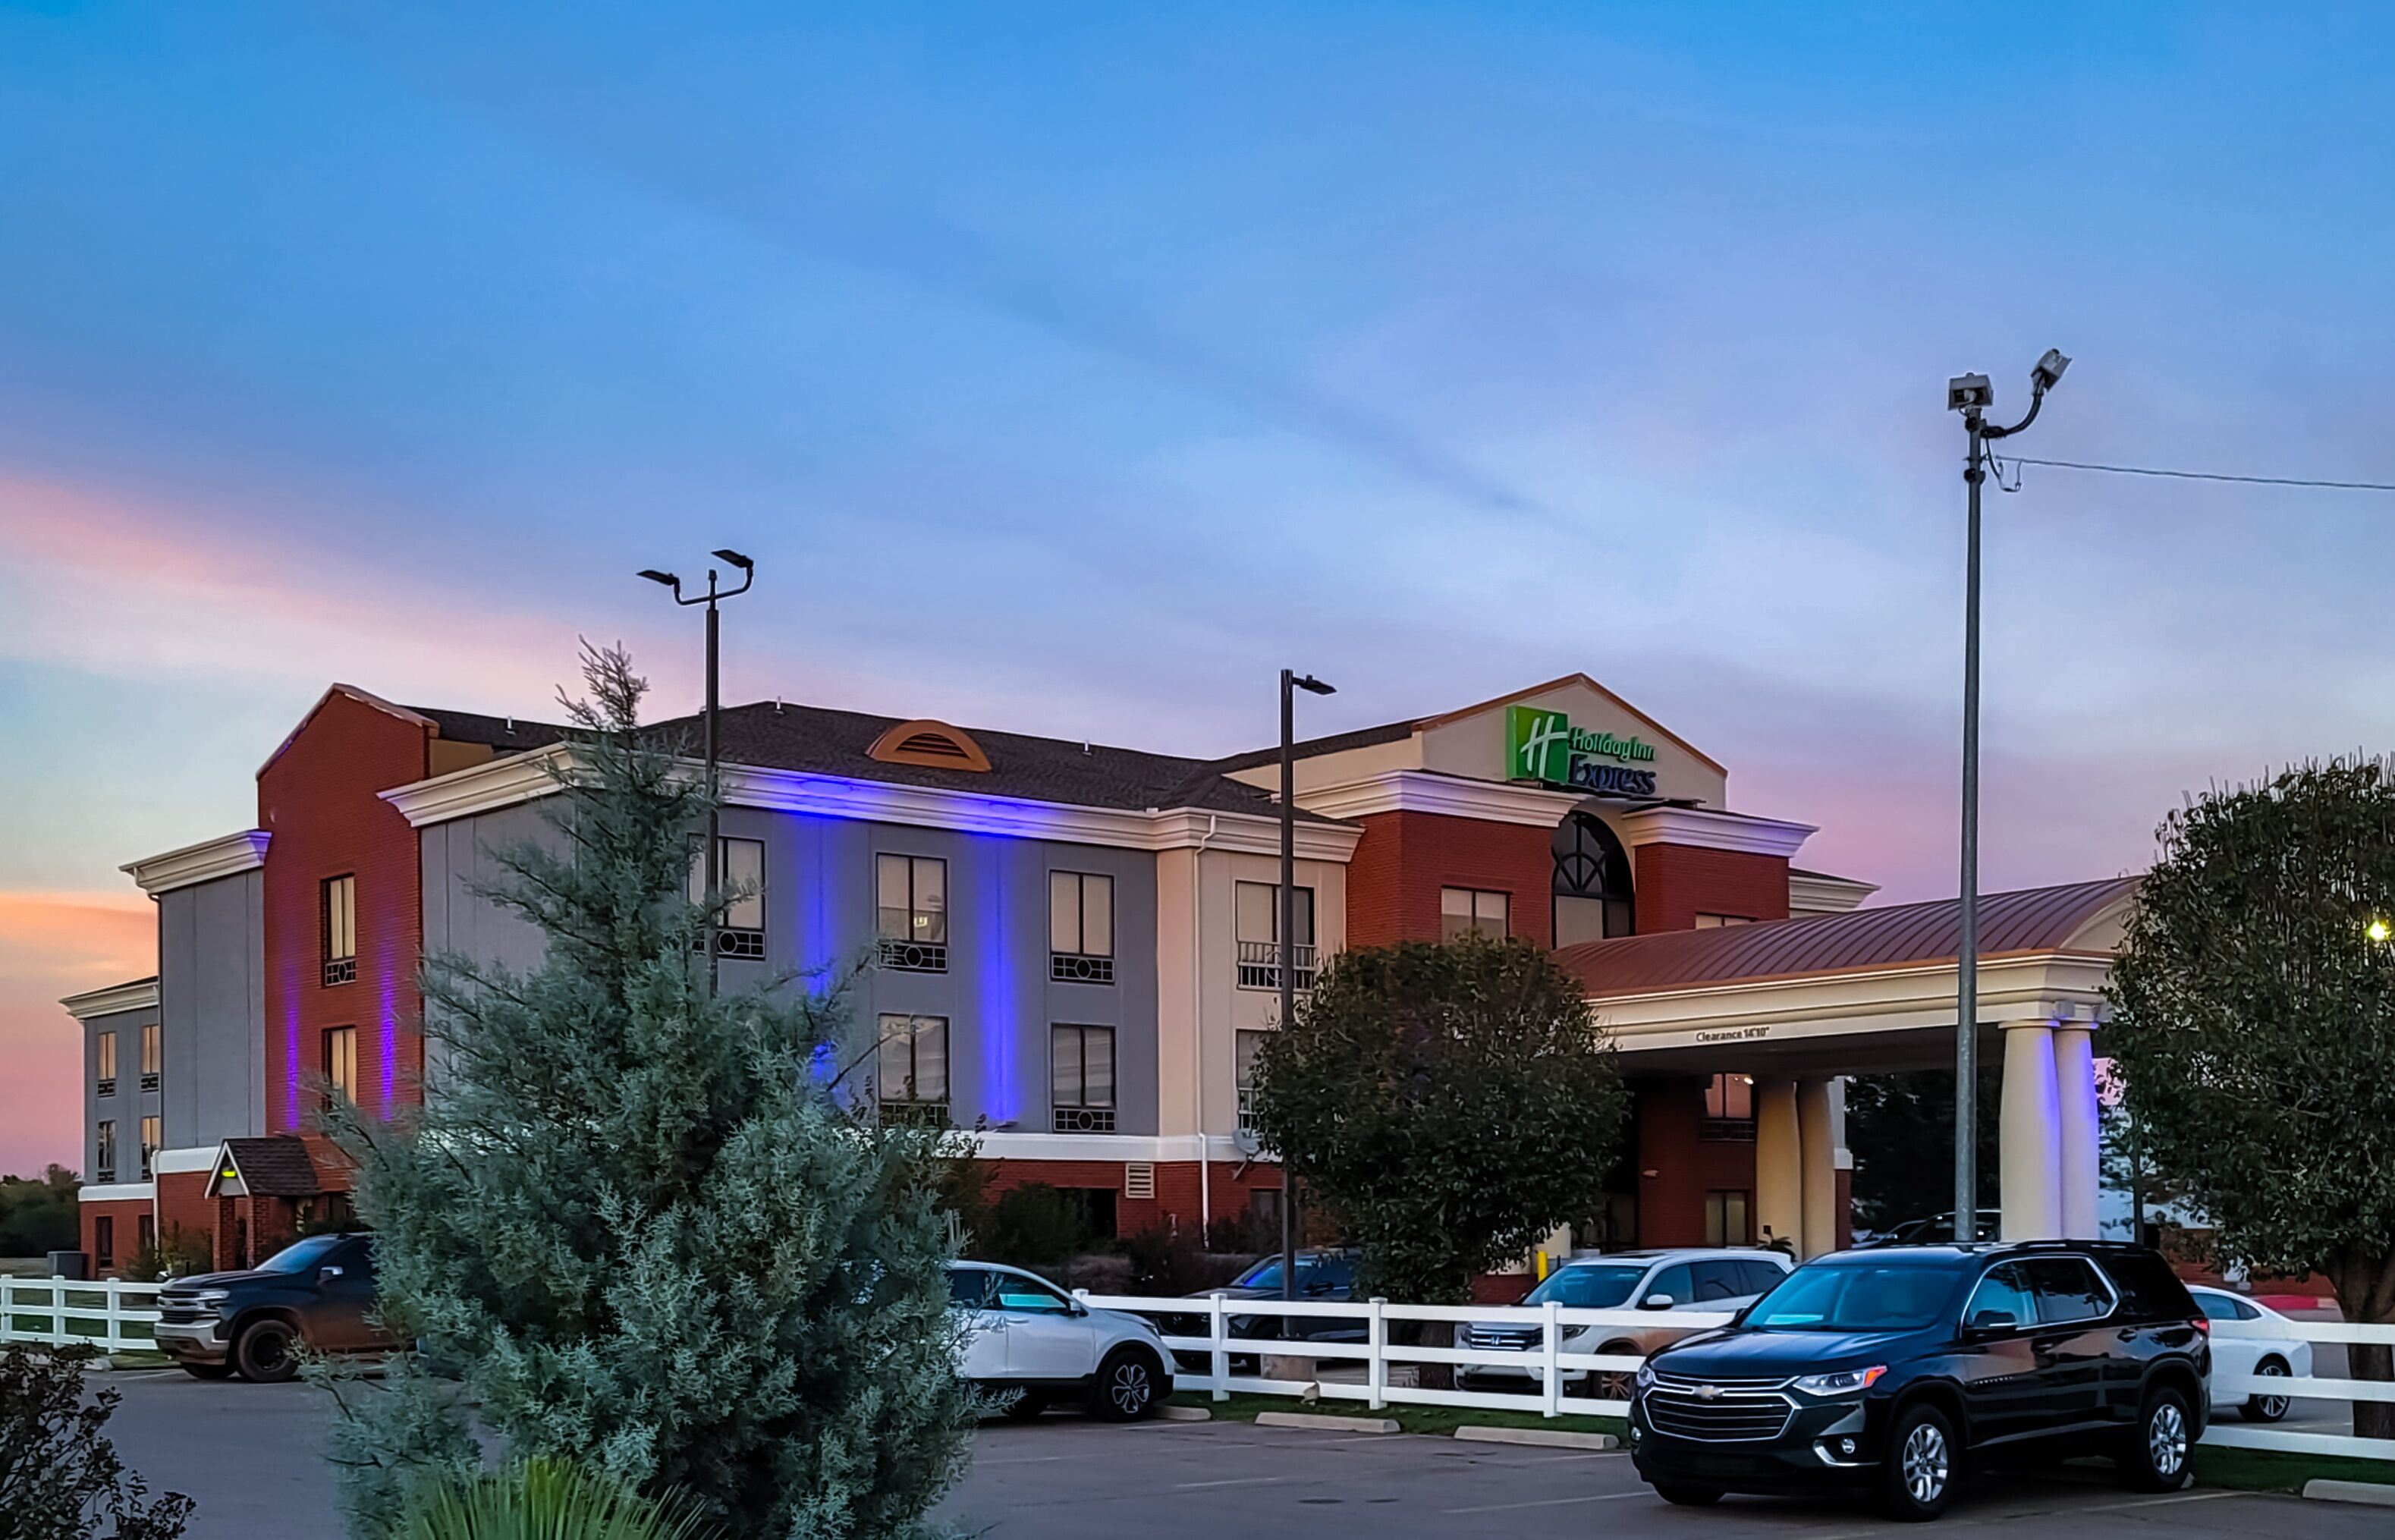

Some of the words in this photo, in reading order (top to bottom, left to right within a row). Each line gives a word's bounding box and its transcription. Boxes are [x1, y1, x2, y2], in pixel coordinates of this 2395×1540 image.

[1568, 727, 1631, 762] Holiday
[1633, 737, 1655, 761] Inn
[1568, 753, 1656, 795] Express
[1696, 1030, 1743, 1042] Clearance
